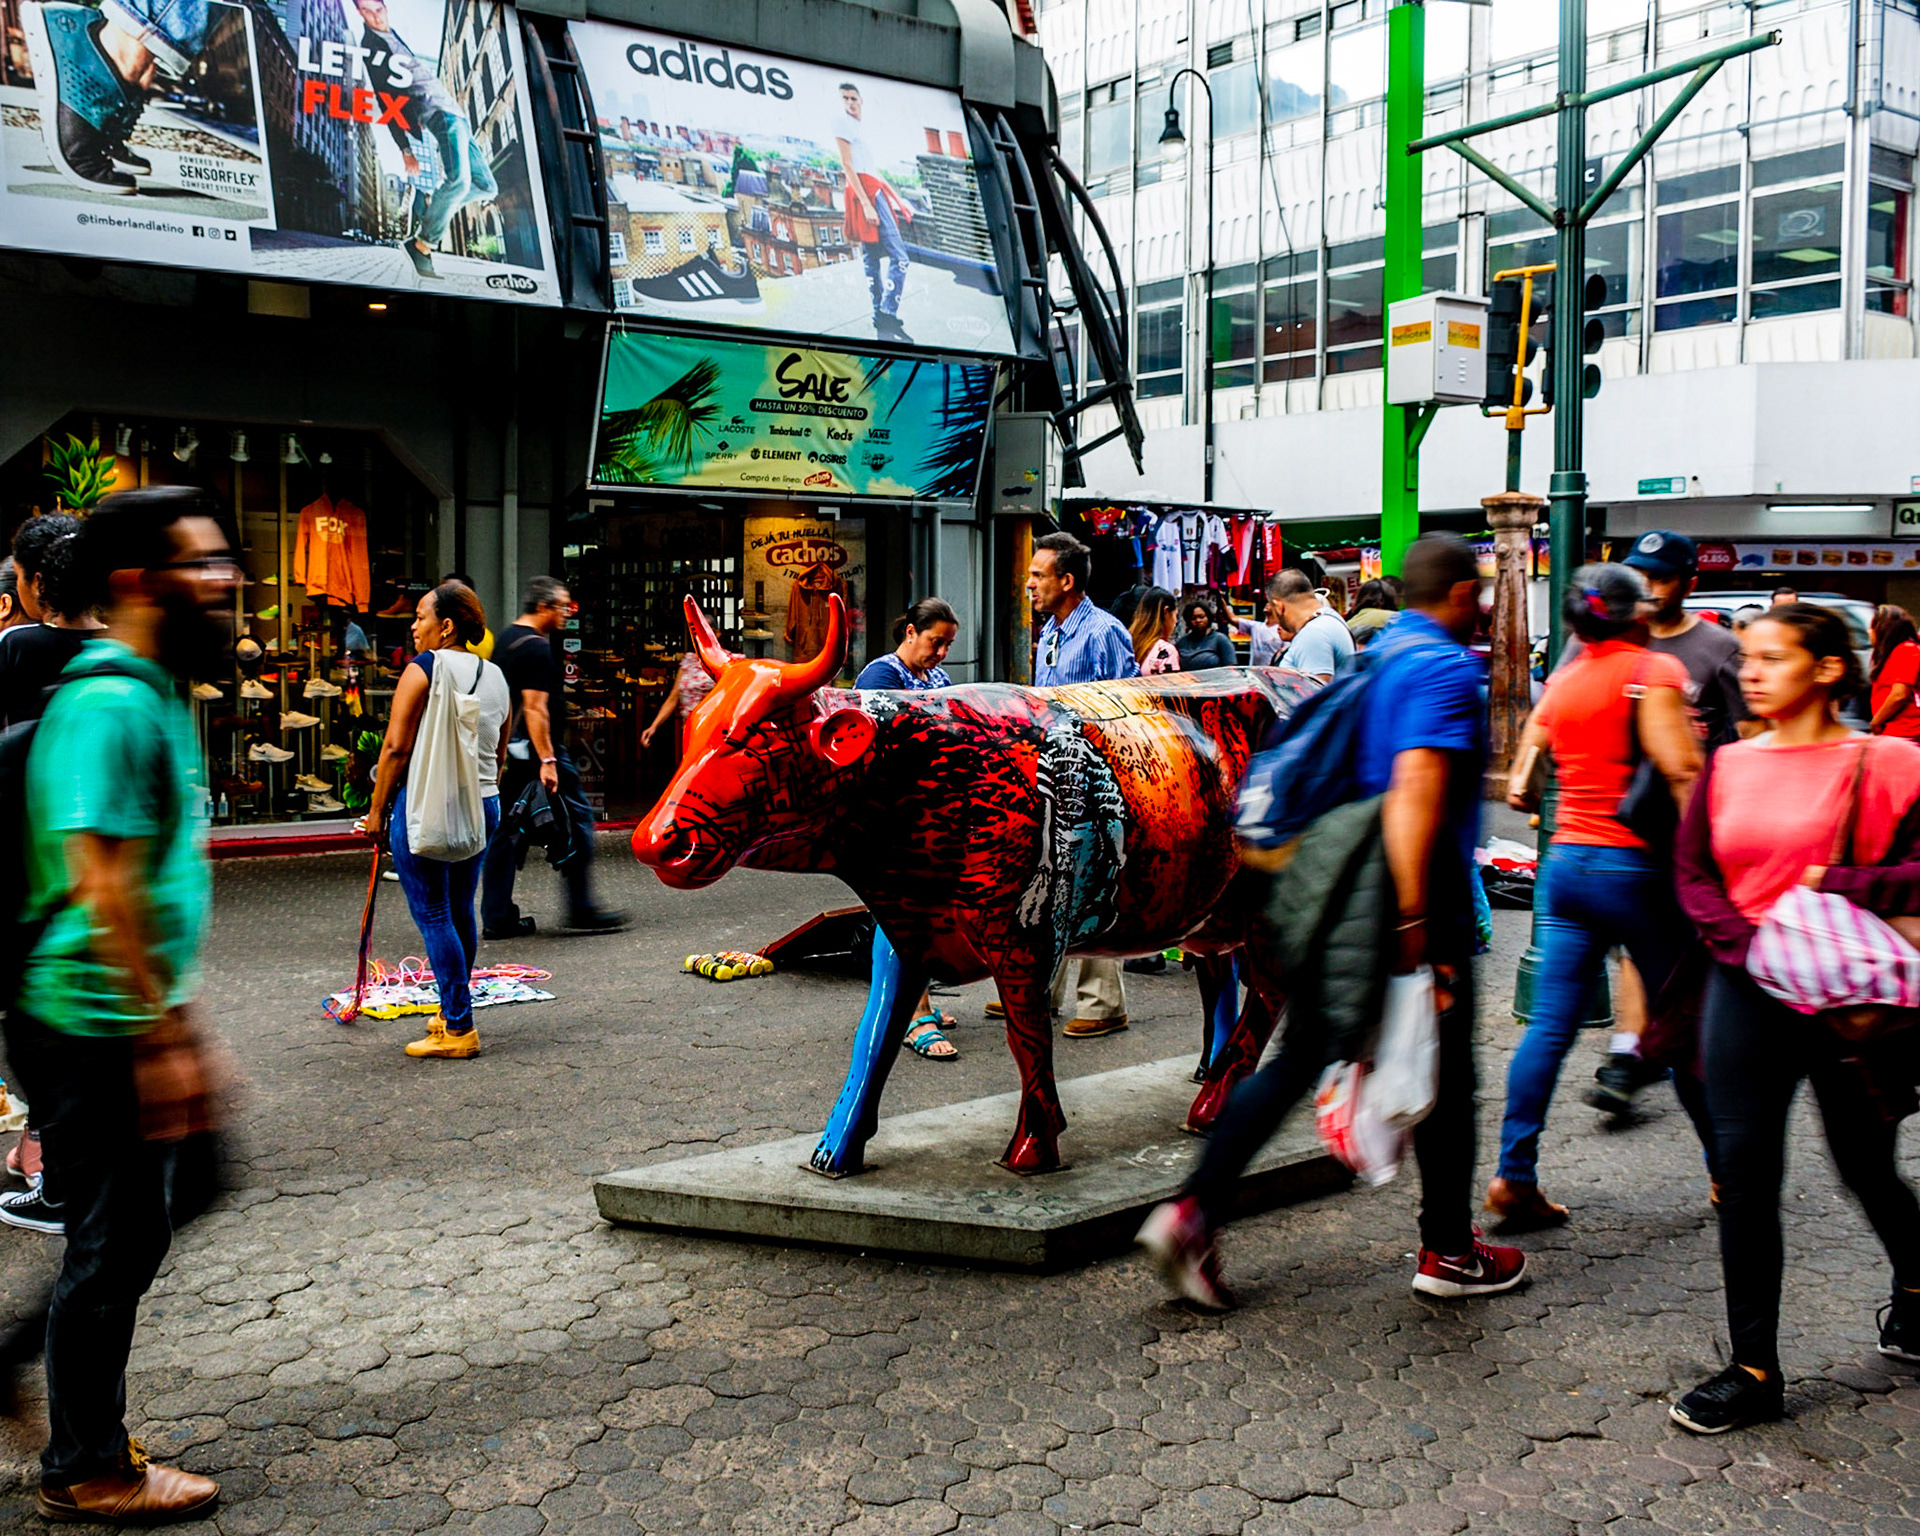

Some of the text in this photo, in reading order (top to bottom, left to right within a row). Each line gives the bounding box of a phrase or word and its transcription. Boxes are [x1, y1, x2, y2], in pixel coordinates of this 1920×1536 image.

[298, 36, 413, 88] LET'S
[626, 41, 793, 100] adidas
[303, 79, 411, 130] FLEX
[179, 155, 213, 166] POWERED
[179, 164, 256, 187] SENSORFLEX
[181, 179, 242, 194] COMFORT SYSTEM
[77, 212, 184, 234] @timberlandlatino
[488, 274, 534, 290] cachos
[775, 352, 851, 403] SALE
[755, 401, 865, 418] HASTA UN 50% DESCUENTO
[718, 425, 756, 435] LACOSTE
[769, 424, 803, 437] Timberland
[826, 427, 854, 441] Keds
[705, 451, 739, 460] SPERRY
[762, 449, 801, 461] ELEMENT
[819, 453, 847, 465] OSIRIS
[315, 516, 348, 537] FOX
[751, 528, 831, 550] DEJÁ TU HUELLA
[771, 541, 841, 564] cachos
